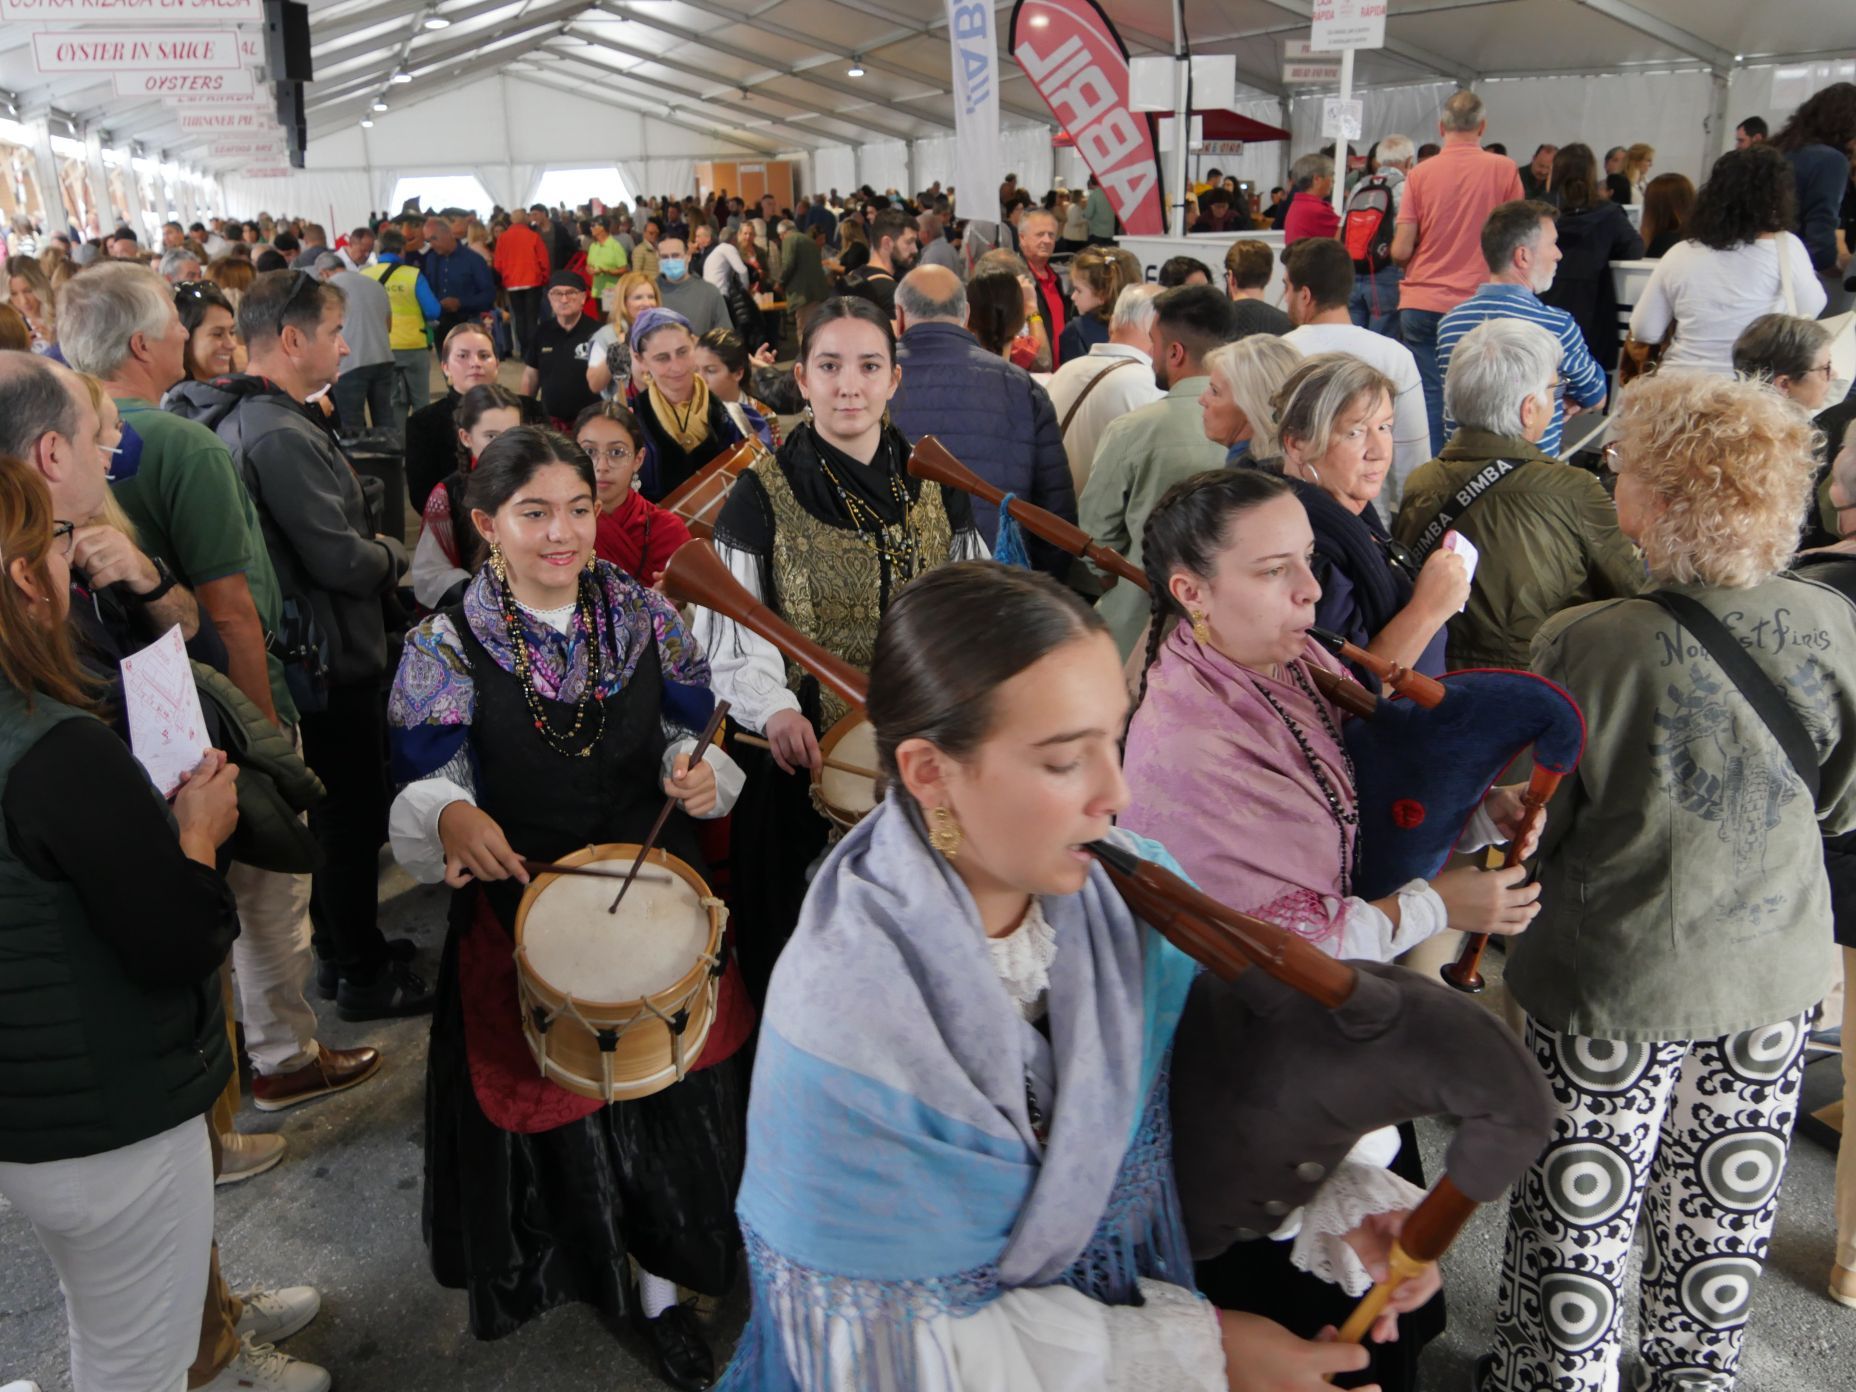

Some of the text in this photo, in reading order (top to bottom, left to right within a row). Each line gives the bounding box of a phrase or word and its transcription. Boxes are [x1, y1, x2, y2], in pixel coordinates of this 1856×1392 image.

[56, 40, 216, 62] OYSTER IN SAUCE
[145, 75, 224, 91] OYSTERS
[1455, 459, 1513, 507] BIMBA
[1411, 512, 1453, 561] BIMBA
